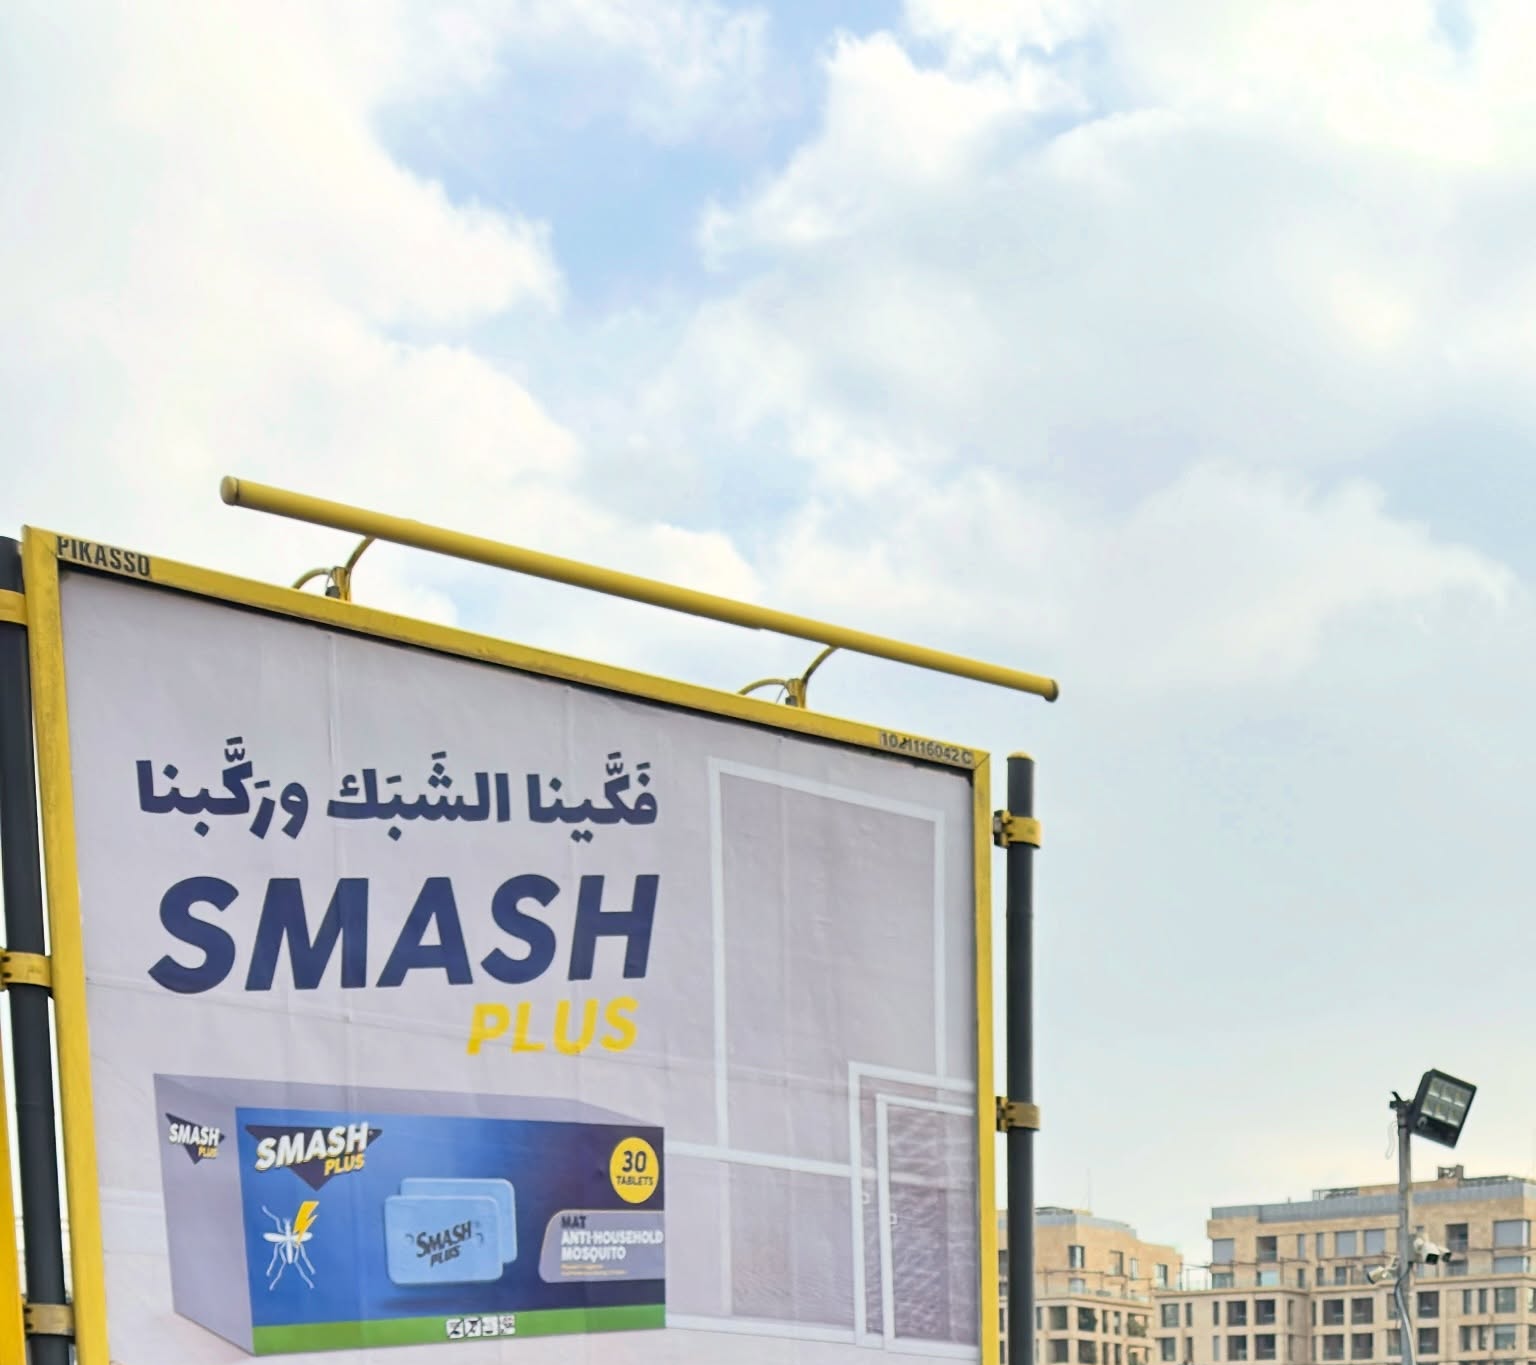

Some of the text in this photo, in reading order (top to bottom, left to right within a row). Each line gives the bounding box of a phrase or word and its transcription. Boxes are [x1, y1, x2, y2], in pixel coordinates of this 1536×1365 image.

[57, 536, 151, 577] PIKASSO
[147, 873, 660, 995] SMASH
[465, 996, 640, 1056] PLUS
[168, 1123, 221, 1147] SMASH
[255, 1121, 369, 1172] SMASH
[198, 1146, 219, 1159] PLUS
[324, 1152, 366, 1177] PLUS
[621, 1150, 648, 1173] 30
[616, 1175, 654, 1186] TABLETS
[561, 1216, 586, 1229] MAT
[416, 1220, 472, 1258] SMASH
[429, 1245, 462, 1268] PLUS
[561, 1245, 627, 1263] MOSQUITO
